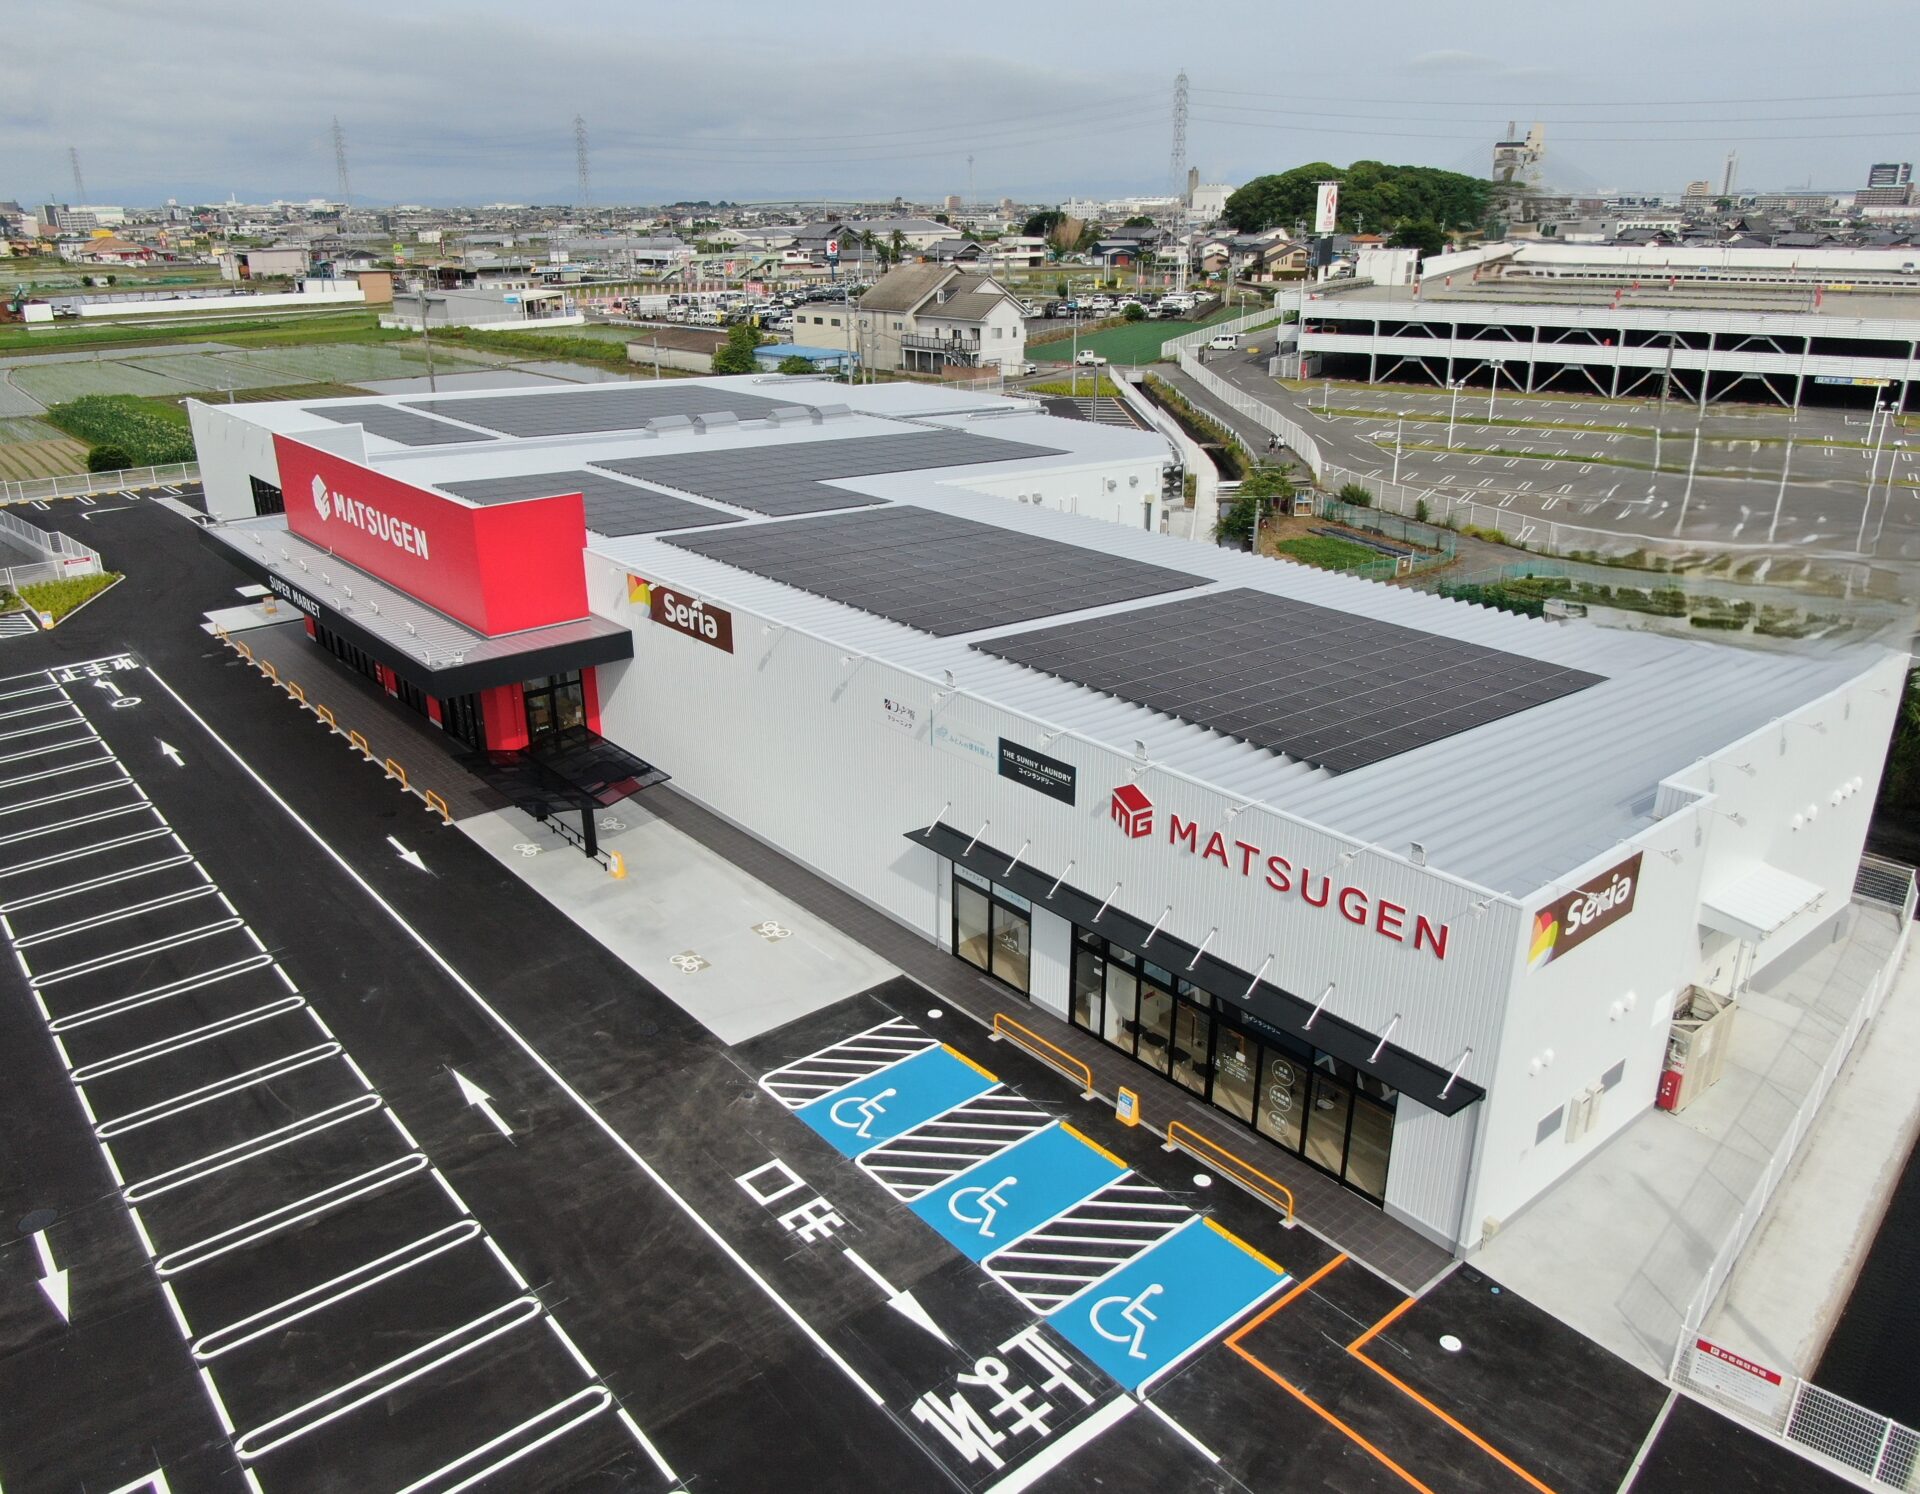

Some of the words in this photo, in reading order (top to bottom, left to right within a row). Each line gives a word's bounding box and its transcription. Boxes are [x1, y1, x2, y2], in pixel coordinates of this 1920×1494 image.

[332, 491, 429, 561] MATSUGEN
[270, 575, 292, 600] SUPER
[292, 589, 320, 618] MARKET
[663, 592, 718, 639] Seria
[61, 657, 140, 683] 止まれ
[1003, 749, 1015, 760] THE
[1016, 754, 1039, 770] SUNNY
[1040, 763, 1072, 783] LAUNDRY
[1018, 766, 1055, 786] コインランドリー
[1169, 813, 1449, 960] MATSUGEN
[911, 1325, 1097, 1471] 止まれ
